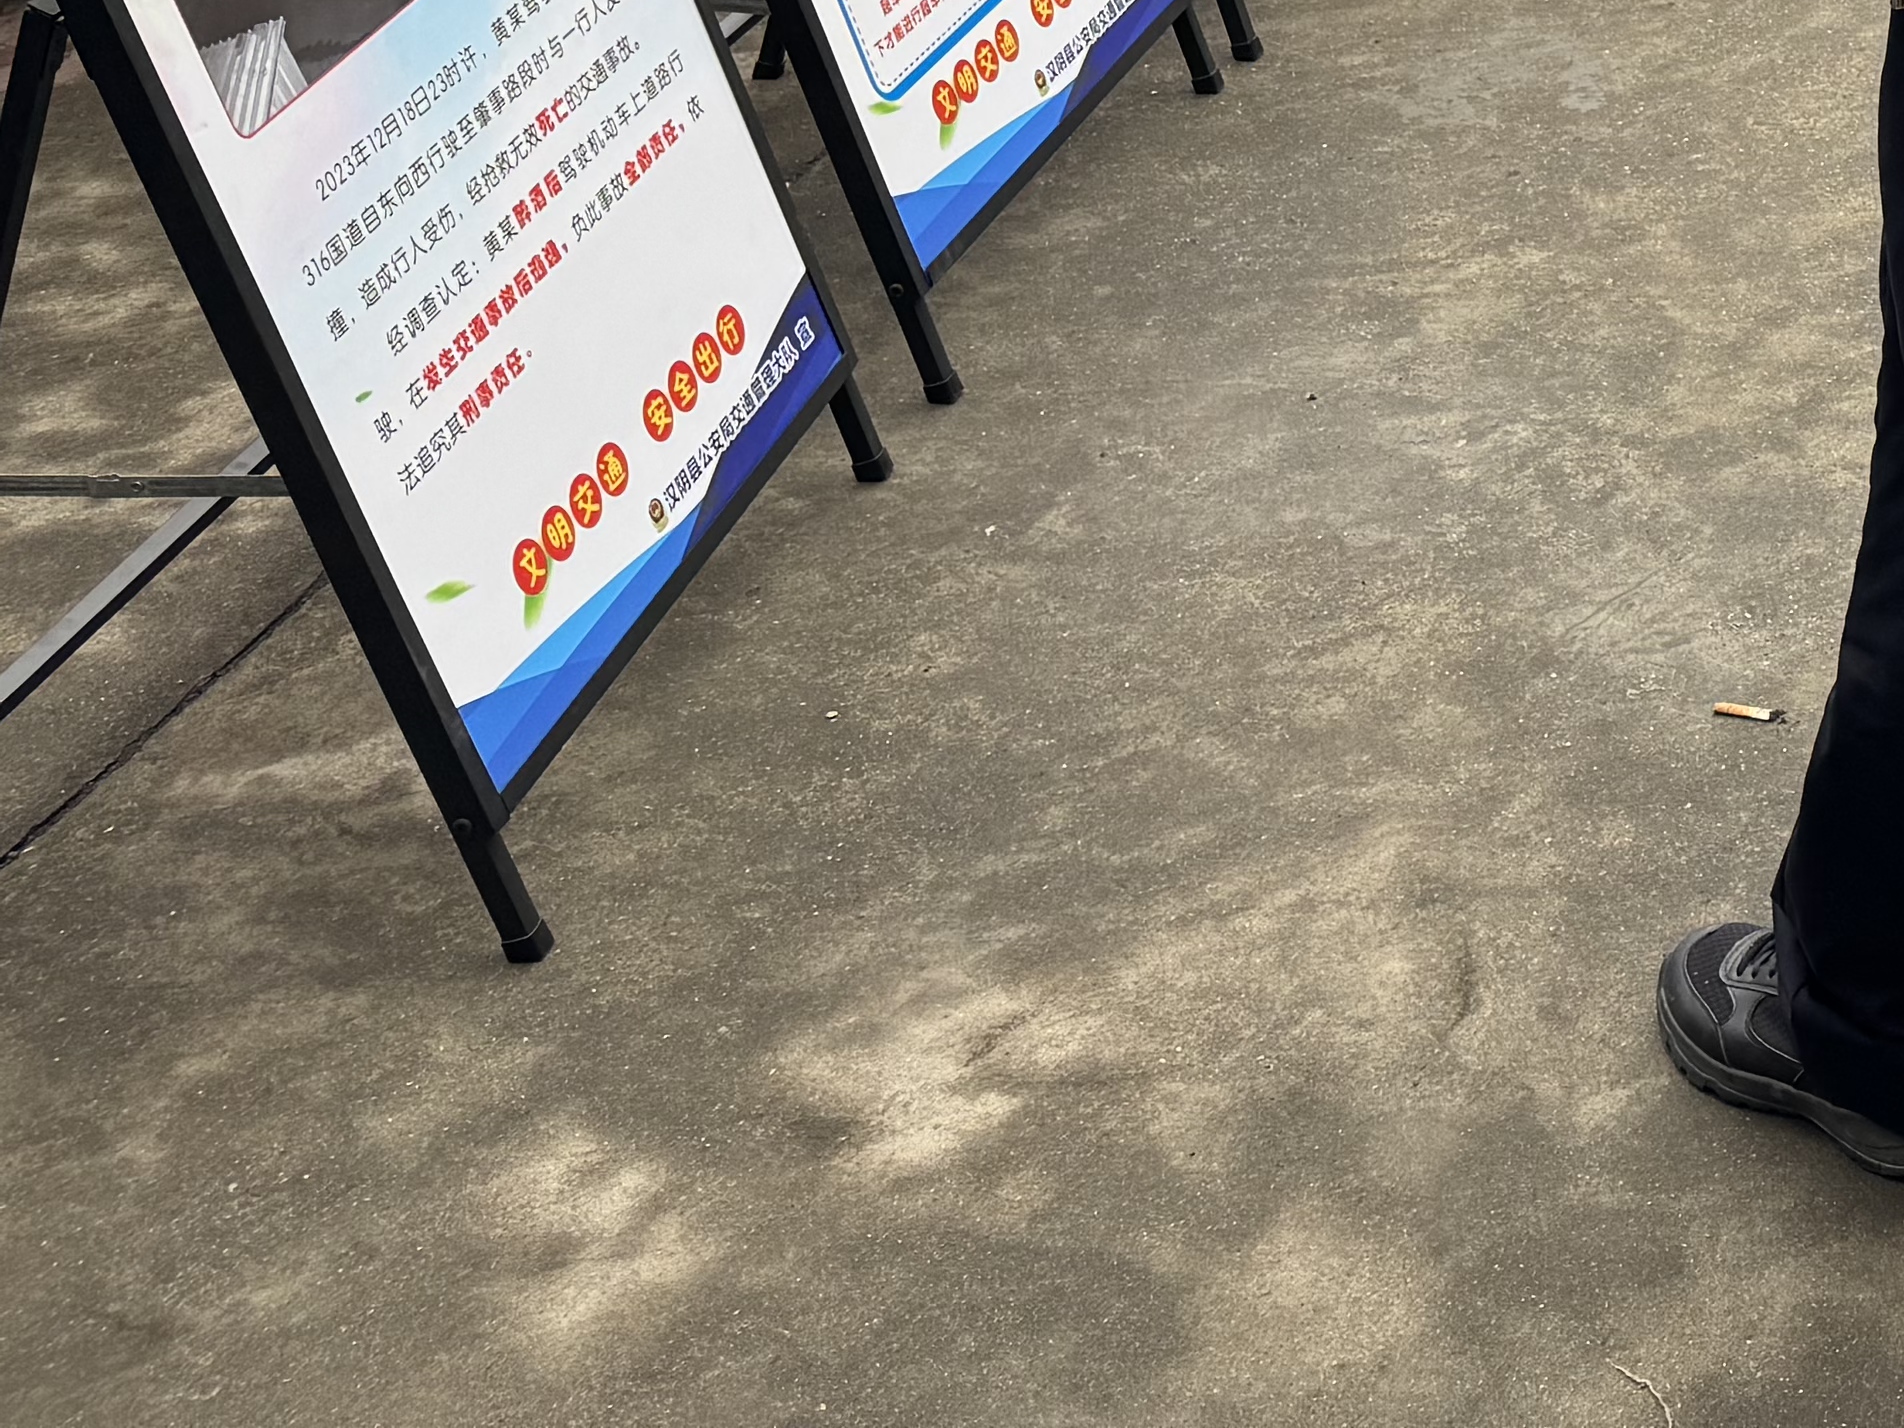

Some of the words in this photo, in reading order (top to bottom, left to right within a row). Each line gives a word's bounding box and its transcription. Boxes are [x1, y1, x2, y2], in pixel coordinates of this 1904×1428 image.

[935, 23, 1017, 121] 文明交通
[518, 447, 627, 588] 文明交通
[646, 310, 743, 438] 安全出行
[661, 337, 798, 515] 汉阴县公安局交通管理大队
[794, 314, 814, 350] 宣
